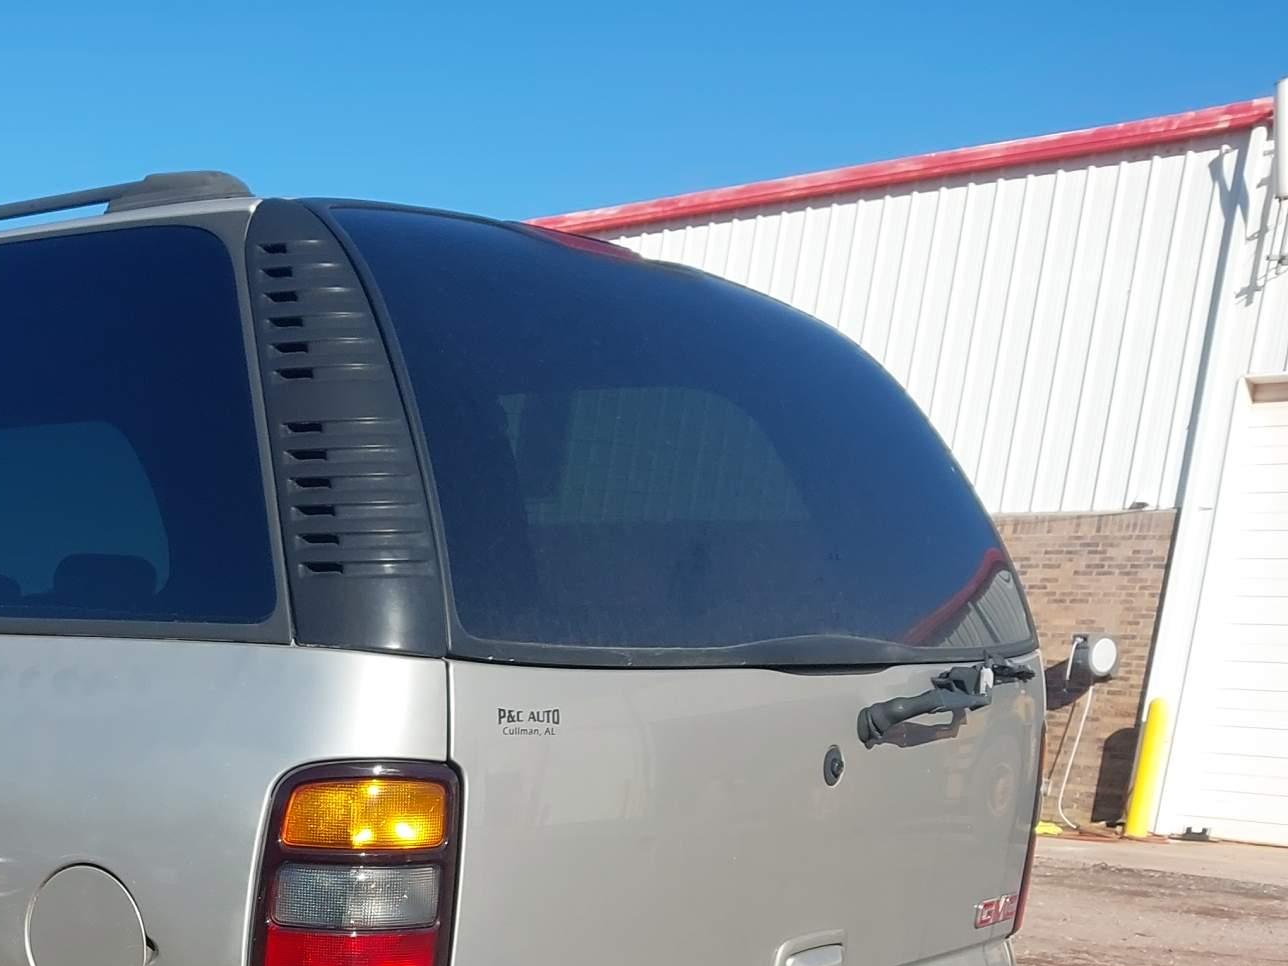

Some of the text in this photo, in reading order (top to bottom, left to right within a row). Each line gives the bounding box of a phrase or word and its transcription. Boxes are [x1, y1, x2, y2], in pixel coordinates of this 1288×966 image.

[497, 708, 560, 725] P&C AUTO
[502, 727, 557, 736] Cullman, AL
